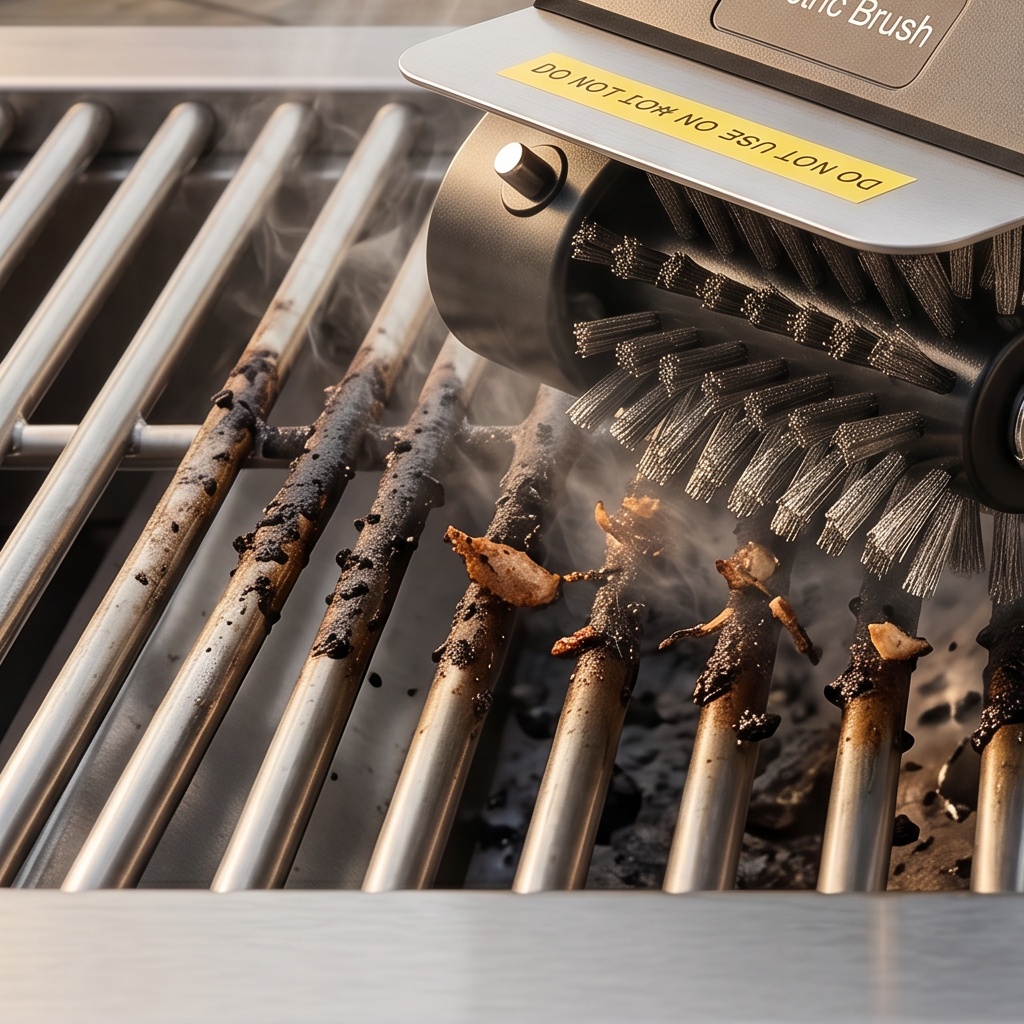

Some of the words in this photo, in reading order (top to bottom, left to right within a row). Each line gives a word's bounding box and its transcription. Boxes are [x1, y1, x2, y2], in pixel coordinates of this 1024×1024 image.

[531, 63, 572, 80] DO
[568, 76, 626, 97] NOT
[674, 113, 719, 132] ON
[718, 129, 777, 154] USE
[774, 150, 839, 175] NOT
[836, 171, 883, 191] DO
